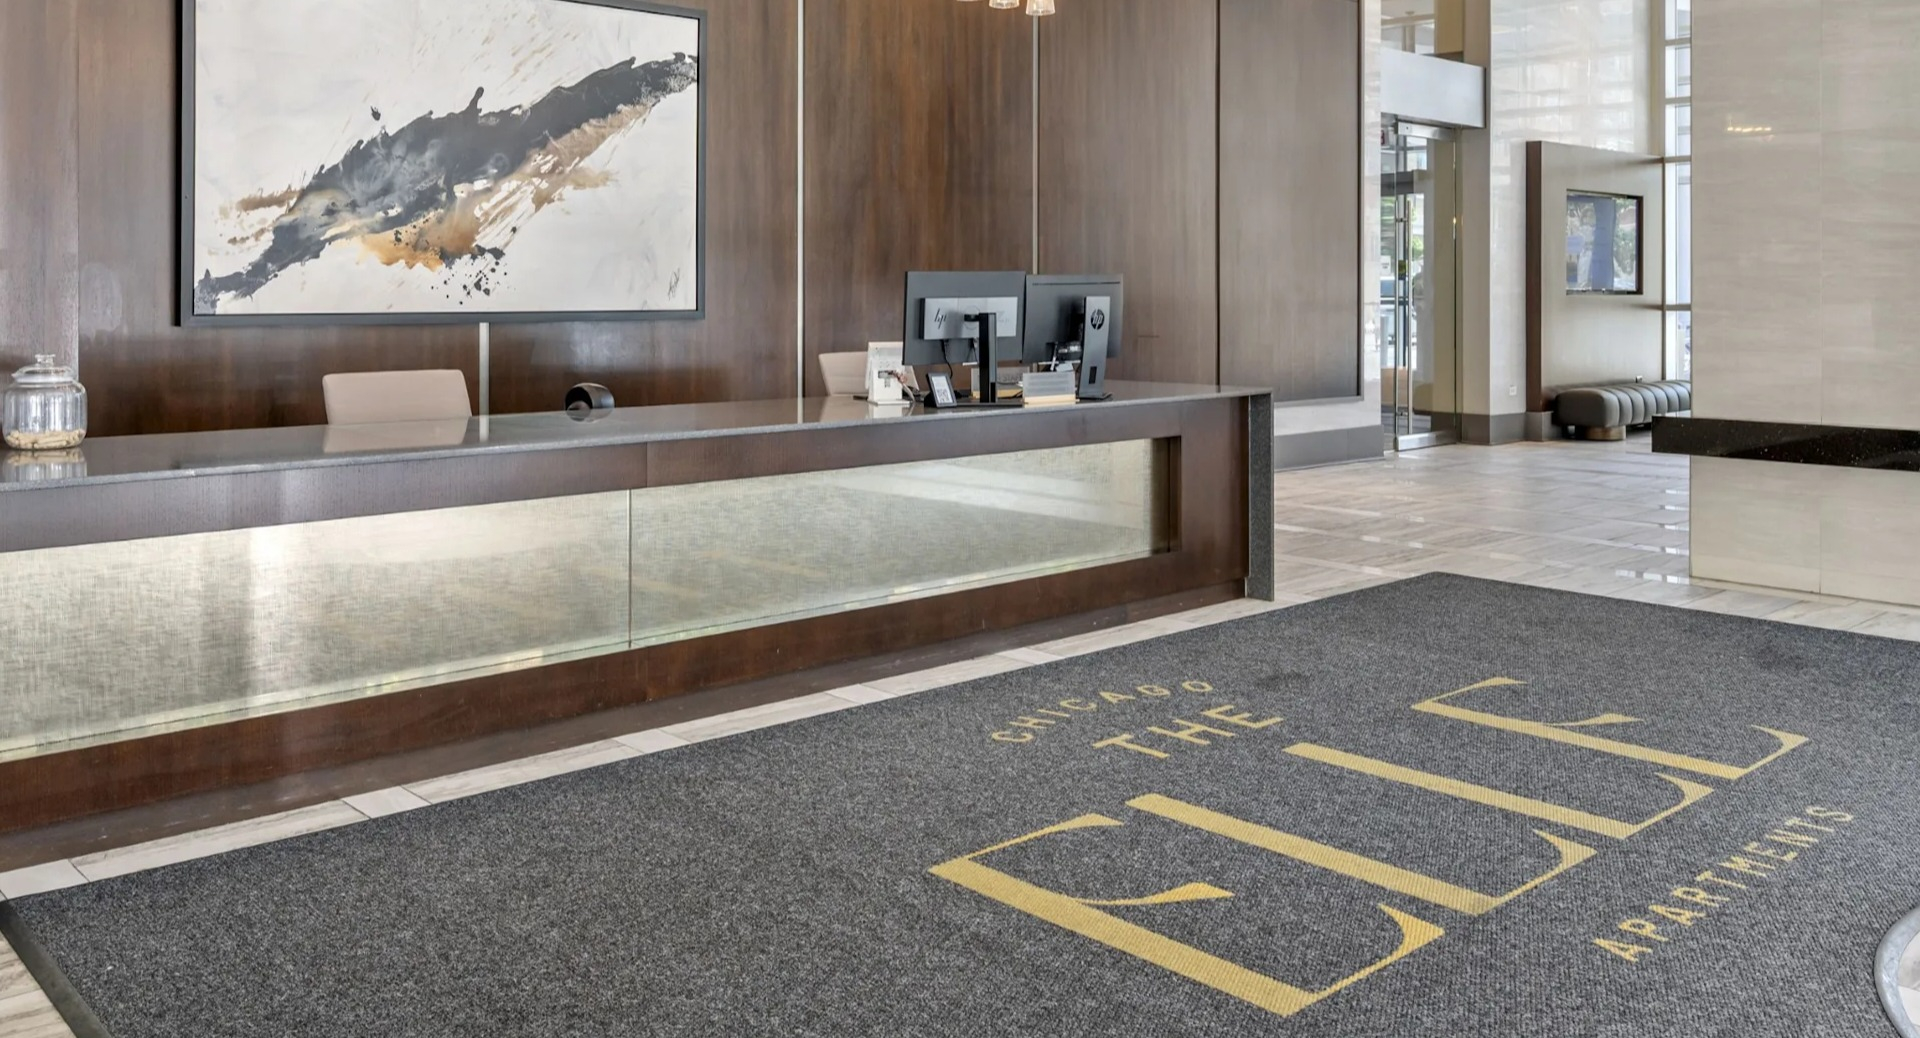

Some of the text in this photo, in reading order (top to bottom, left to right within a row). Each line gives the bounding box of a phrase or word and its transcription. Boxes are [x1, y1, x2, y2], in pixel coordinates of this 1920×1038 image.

[991, 680, 1213, 743] CHICAGO
[1092, 704, 1284, 759] THE
[928, 676, 1809, 1017] ELLE
[1593, 805, 1853, 963] APARTMENTS
